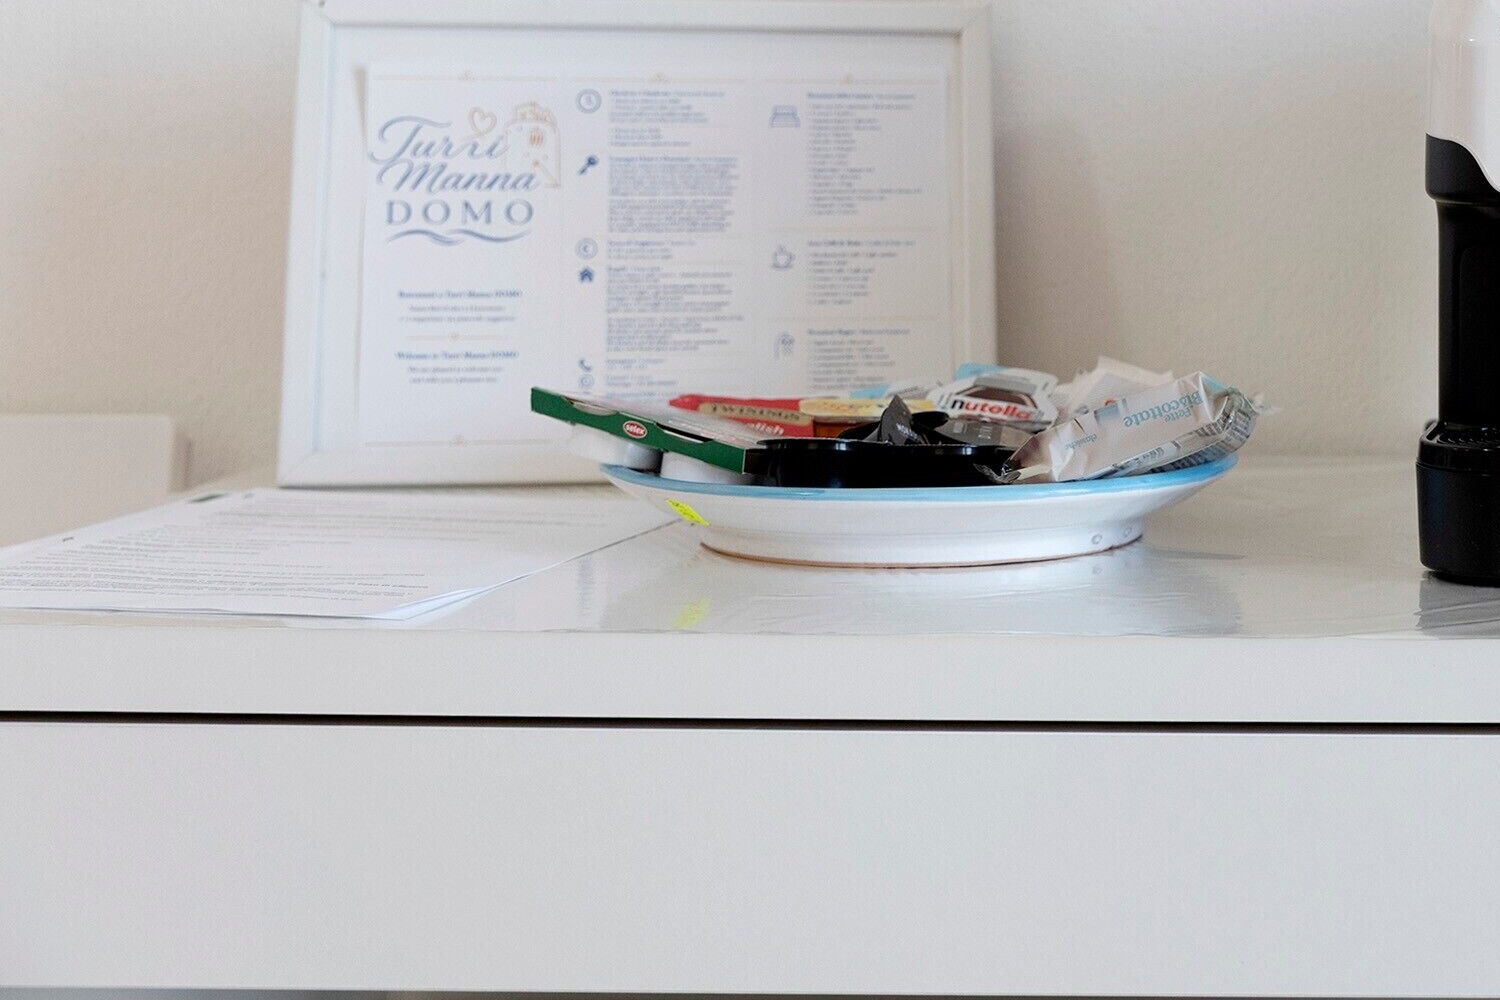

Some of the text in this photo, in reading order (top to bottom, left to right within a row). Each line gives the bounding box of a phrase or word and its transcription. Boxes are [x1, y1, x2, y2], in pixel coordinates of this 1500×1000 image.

[370, 115, 510, 164] Turri
[376, 158, 540, 194] Manna
[386, 199, 534, 225] DOMO
[951, 399, 1033, 421] nutella
